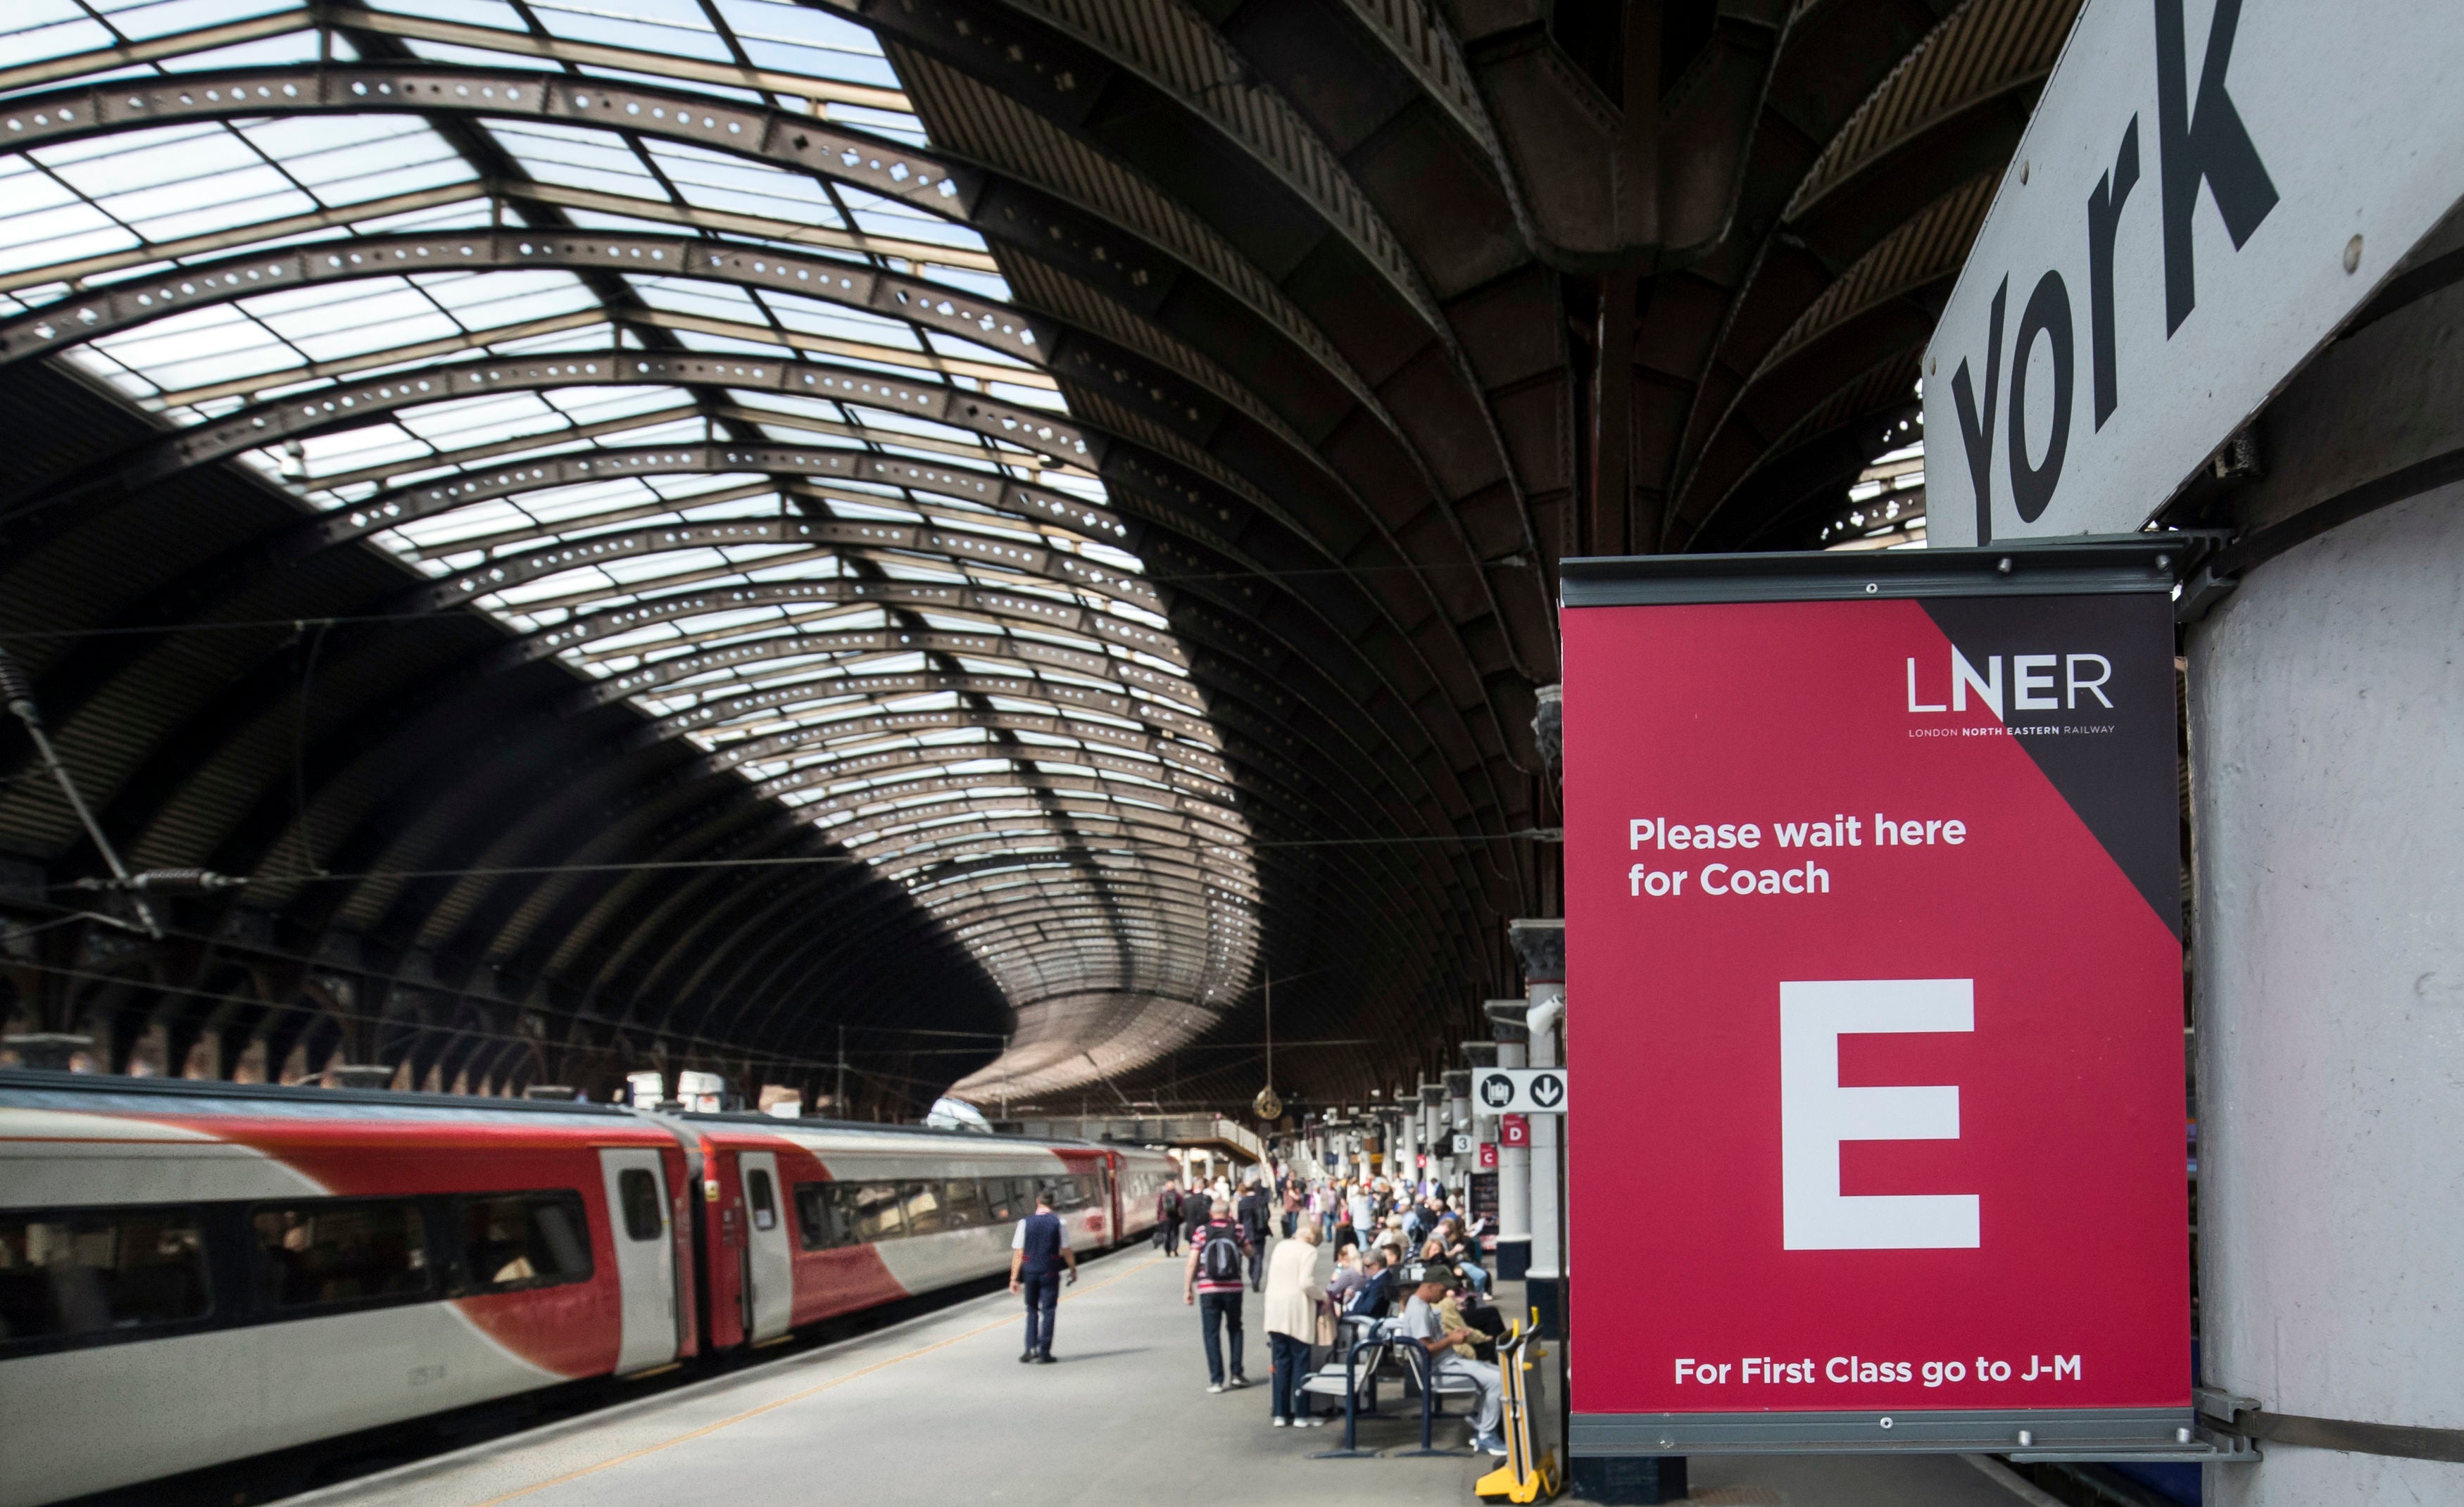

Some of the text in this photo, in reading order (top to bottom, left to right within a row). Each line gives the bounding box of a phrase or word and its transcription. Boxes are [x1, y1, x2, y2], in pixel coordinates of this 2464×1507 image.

[1951, 0, 2280, 546] York
[1907, 643, 2114, 723] LNER
[1909, 725, 2116, 738] LONDON NORTH EASTERN RAILWAY
[1630, 812, 1967, 851] Please wait here
[1628, 860, 1830, 897] for Coach
[1780, 978, 1980, 1251] E
[1458, 1137, 1467, 1149] 3
[1509, 1127, 1522, 1141] D
[1484, 1152, 1492, 1163] C
[1675, 1354, 2082, 1388] For First Class go to J-M
